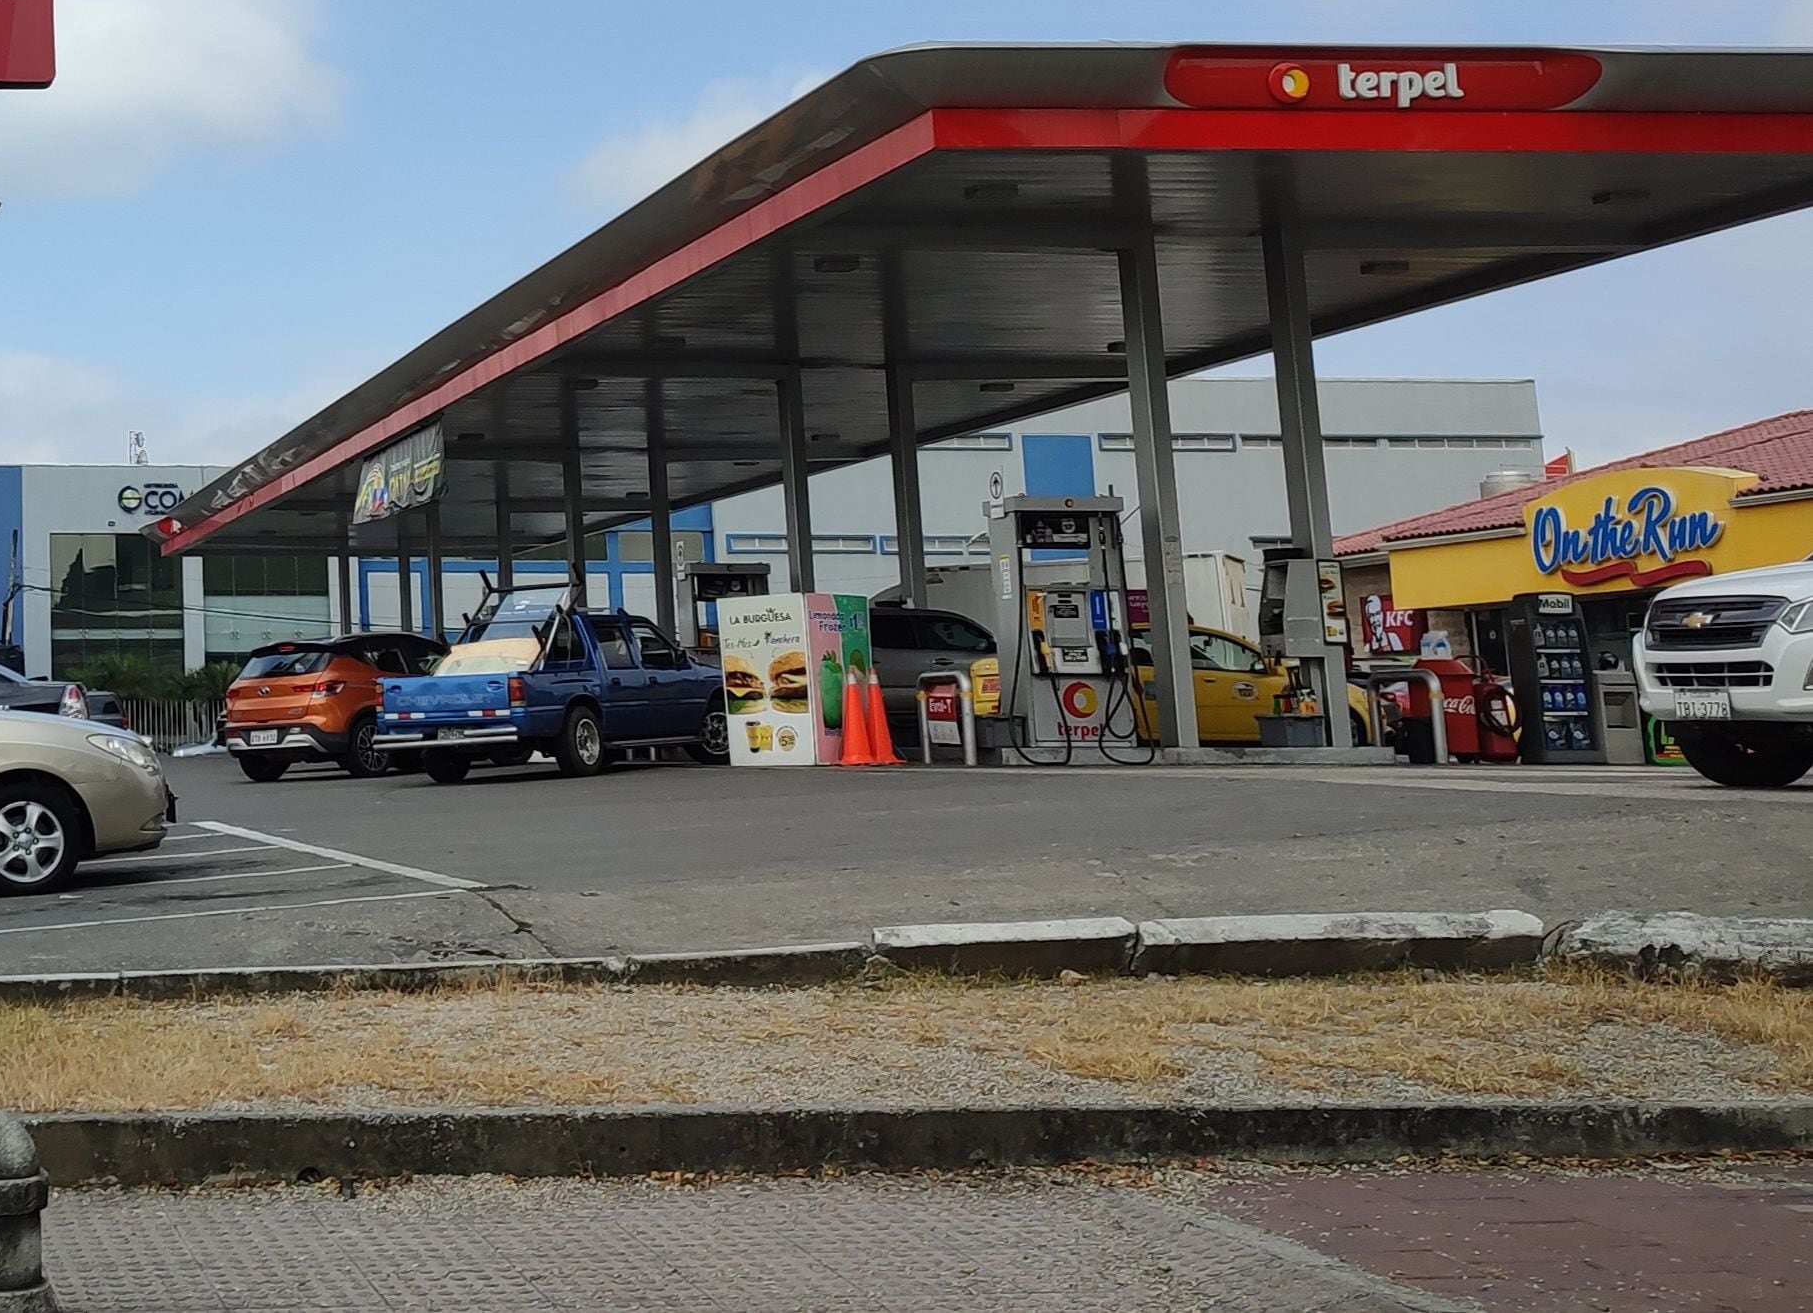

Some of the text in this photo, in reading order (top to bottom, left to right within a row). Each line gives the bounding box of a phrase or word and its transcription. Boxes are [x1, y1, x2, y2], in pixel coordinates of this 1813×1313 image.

[1337, 63, 1465, 108] terpel
[1532, 485, 1726, 575] On the Run
[1538, 597, 1571, 610] Mobil
[729, 615, 741, 625] LA
[1386, 610, 1414, 627] KFC
